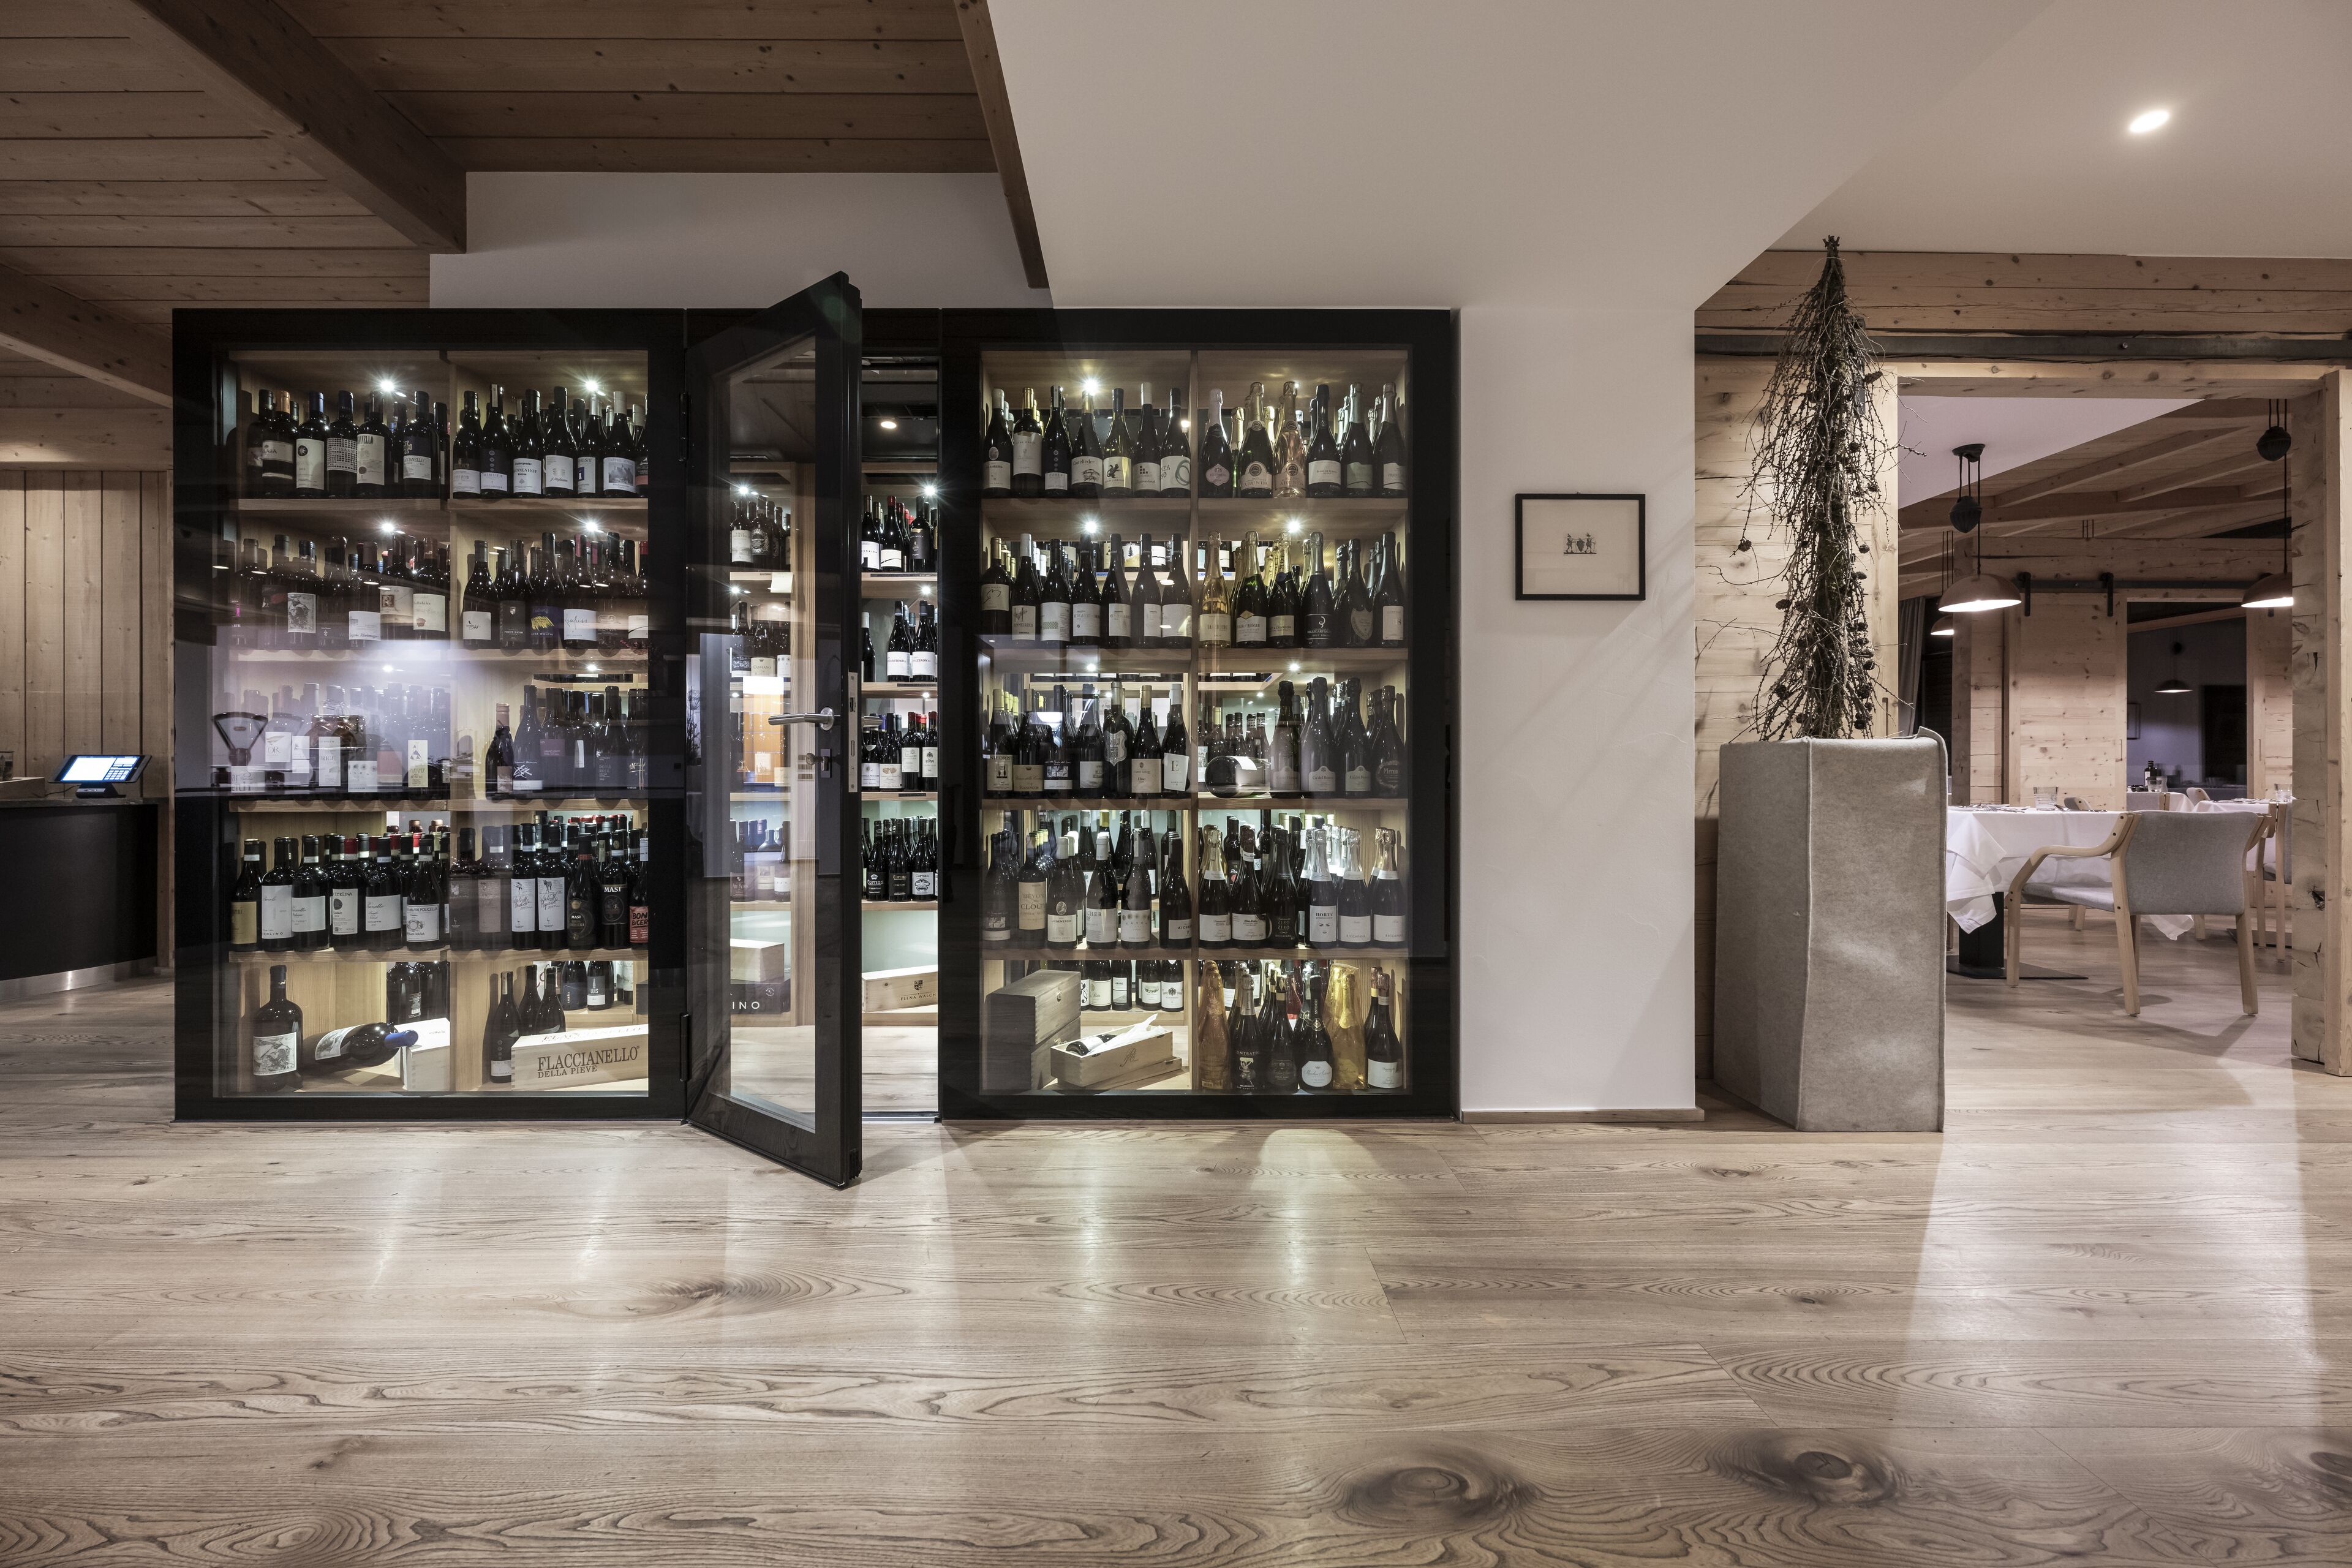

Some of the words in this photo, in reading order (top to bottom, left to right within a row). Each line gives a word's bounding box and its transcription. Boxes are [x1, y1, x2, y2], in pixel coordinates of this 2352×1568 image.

[537, 1046, 638, 1072] FLACCIANELLO
[538, 1069, 567, 1079] DELLA
[571, 1065, 598, 1075] PIEVE
